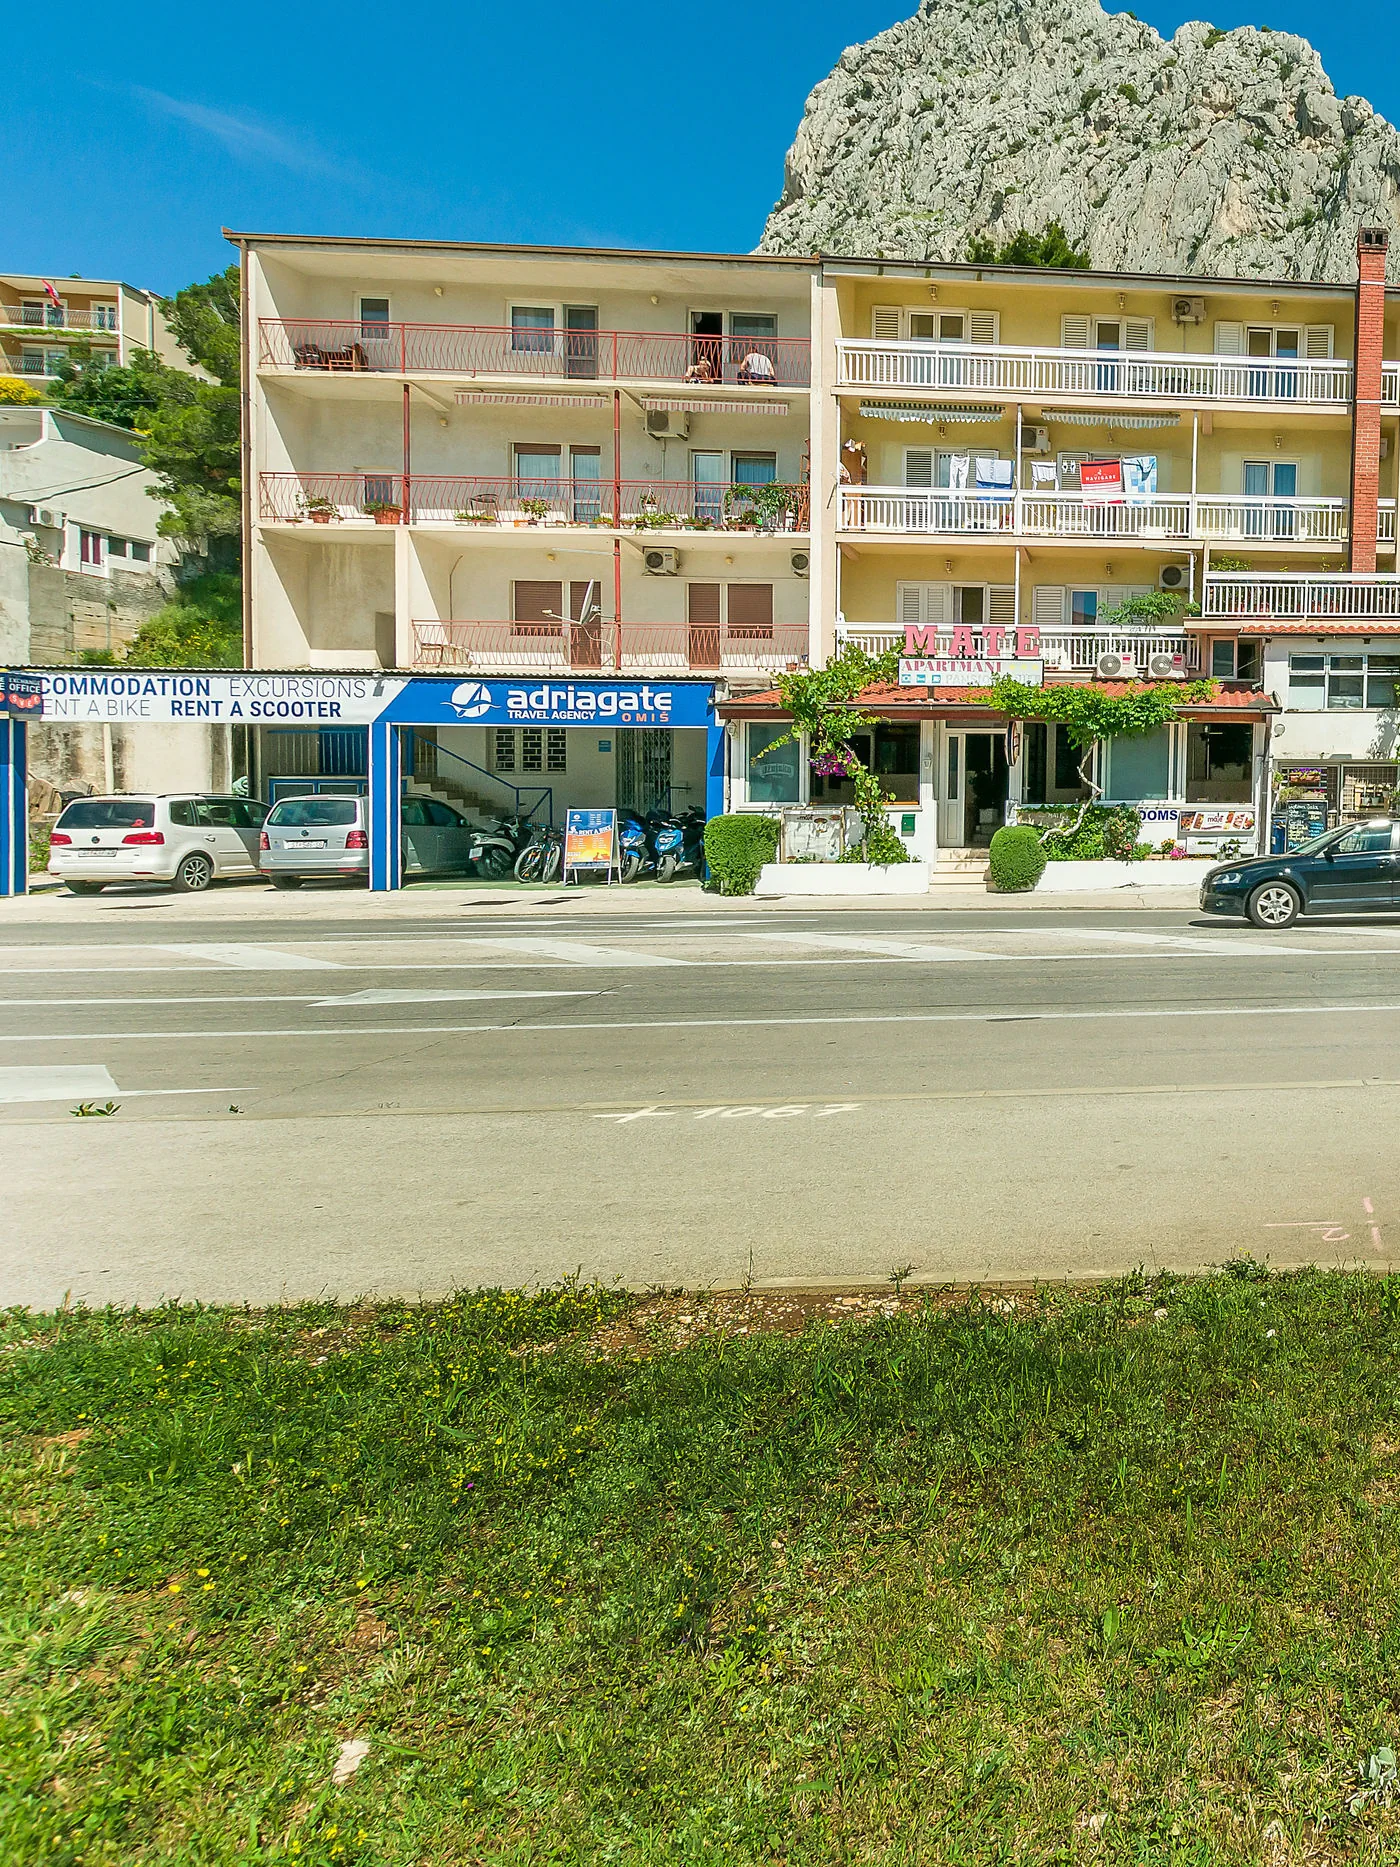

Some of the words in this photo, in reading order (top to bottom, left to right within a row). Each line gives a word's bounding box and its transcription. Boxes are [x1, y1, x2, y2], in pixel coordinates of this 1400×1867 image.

[903, 624, 1040, 657] MATE
[902, 660, 1001, 673] APARTMANI
[9, 683, 41, 694] OFFICE
[41, 676, 210, 697] COMMODATION
[229, 679, 366, 698] EXCURSIONS
[42, 698, 81, 716] ENT
[87, 699, 100, 716] A
[107, 699, 151, 716] BIKE
[171, 700, 223, 717] RENT
[229, 700, 244, 717] A
[250, 700, 342, 718] SCOOTER
[506, 684, 672, 717] adriagate
[507, 709, 550, 720] TRAVEL
[551, 710, 596, 720] AGENCY
[621, 711, 669, 723] OMIŠ
[1140, 809, 1178, 821] OOMS
[693, 1103, 862, 1120] 1067
